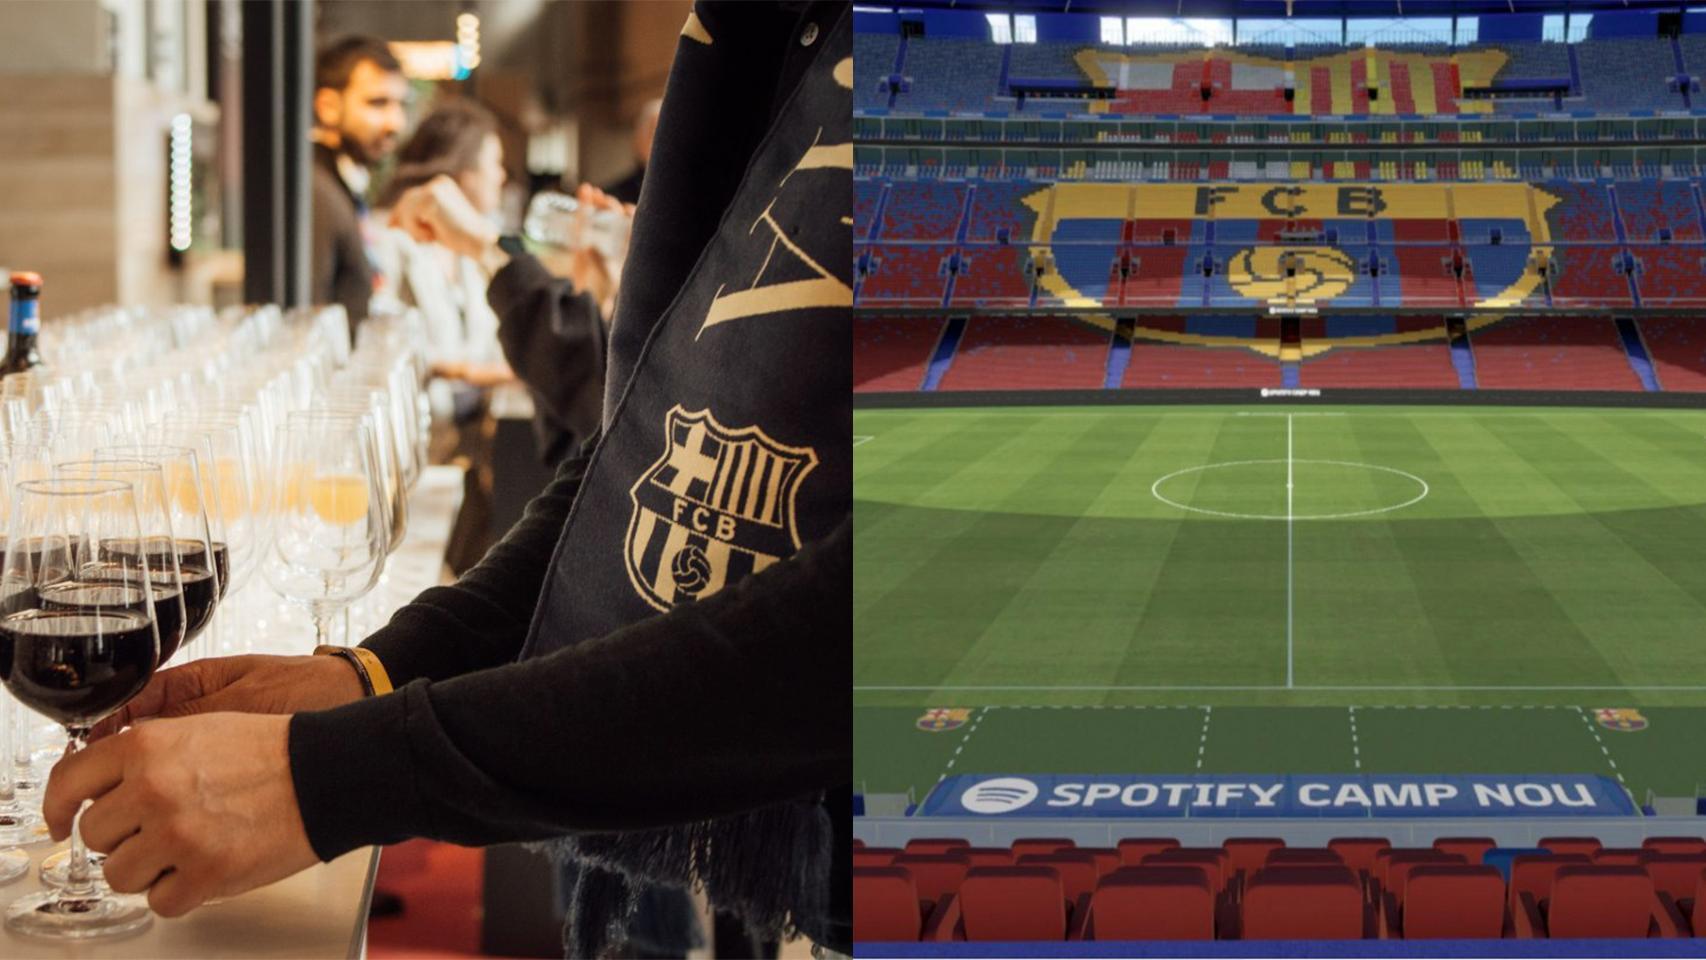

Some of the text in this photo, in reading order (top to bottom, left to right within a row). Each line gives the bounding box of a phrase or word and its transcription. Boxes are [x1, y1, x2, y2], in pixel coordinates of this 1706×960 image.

[673, 499, 736, 540] FCB
[1048, 783, 1596, 806] SPOTIFY CAMP NOU
